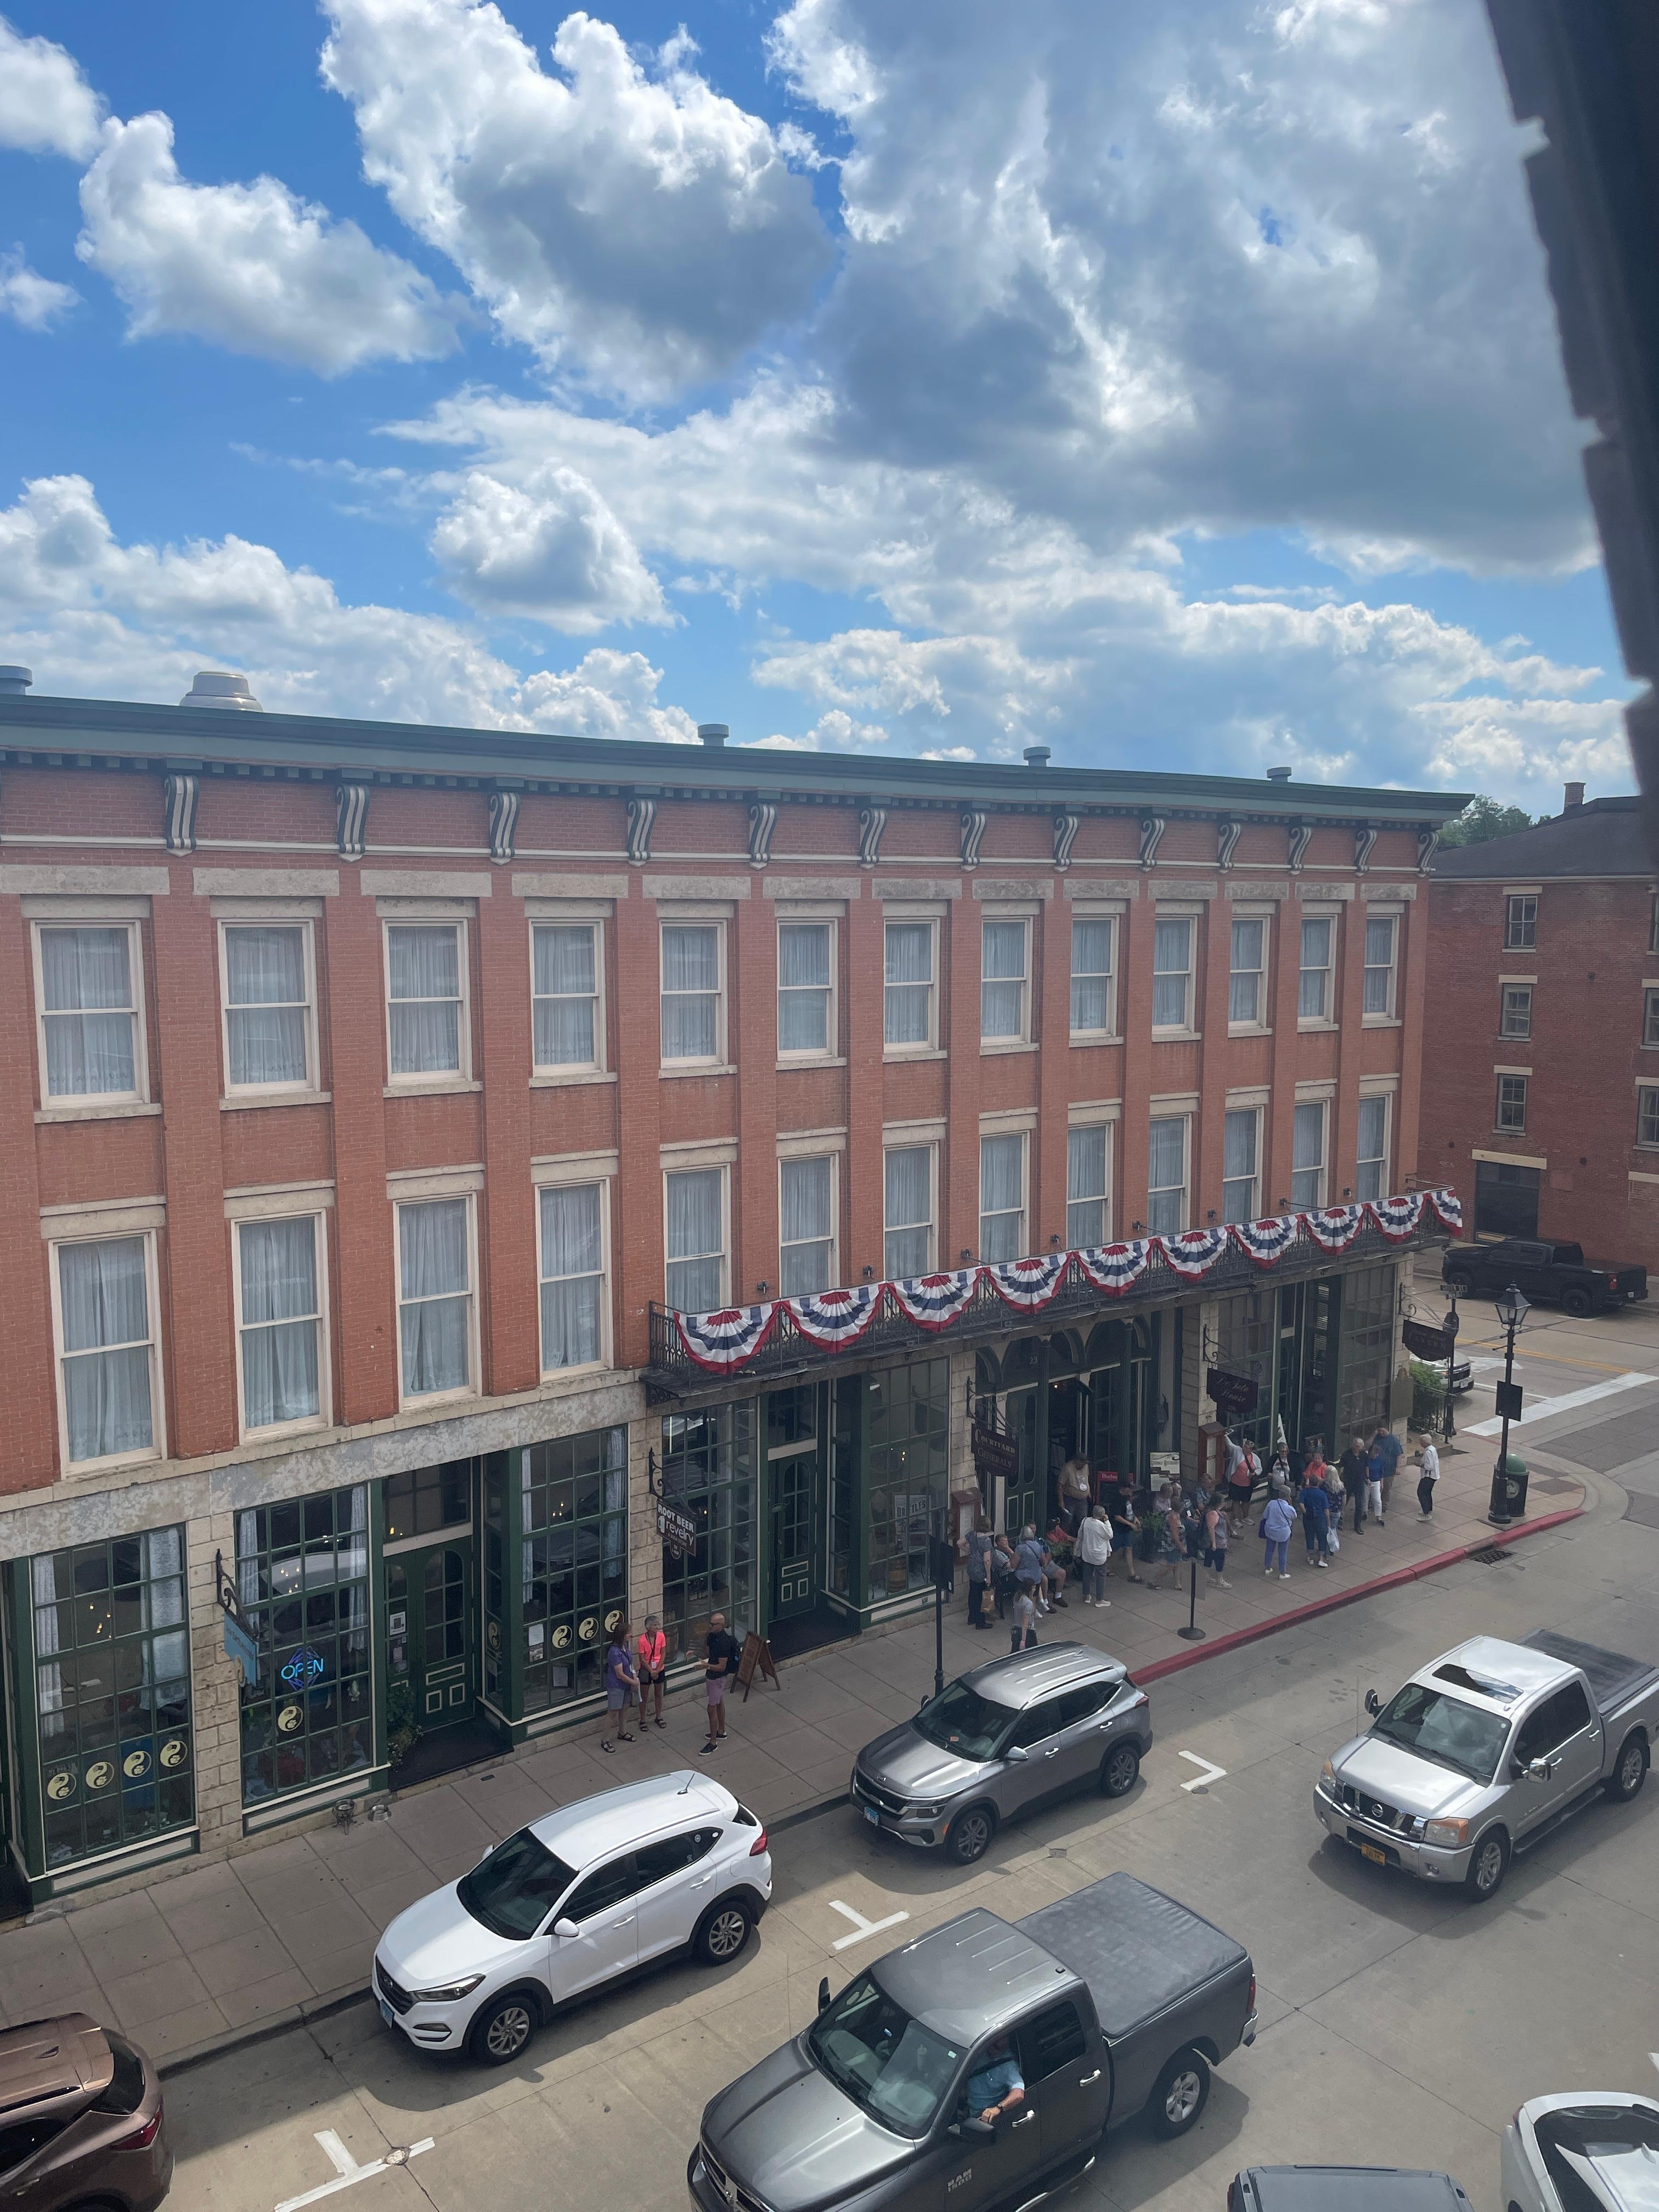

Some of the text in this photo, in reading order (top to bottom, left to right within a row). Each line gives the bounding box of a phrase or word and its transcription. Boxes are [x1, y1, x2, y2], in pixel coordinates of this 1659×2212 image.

[1221, 1389, 1246, 1402] House
[658, 1504, 694, 1533] ROOT BEER
[666, 1521, 693, 1546] revelry
[281, 1658, 324, 1679] OPEN
[947, 2168, 972, 2187] RAM
[948, 2174, 972, 2192] 1500
